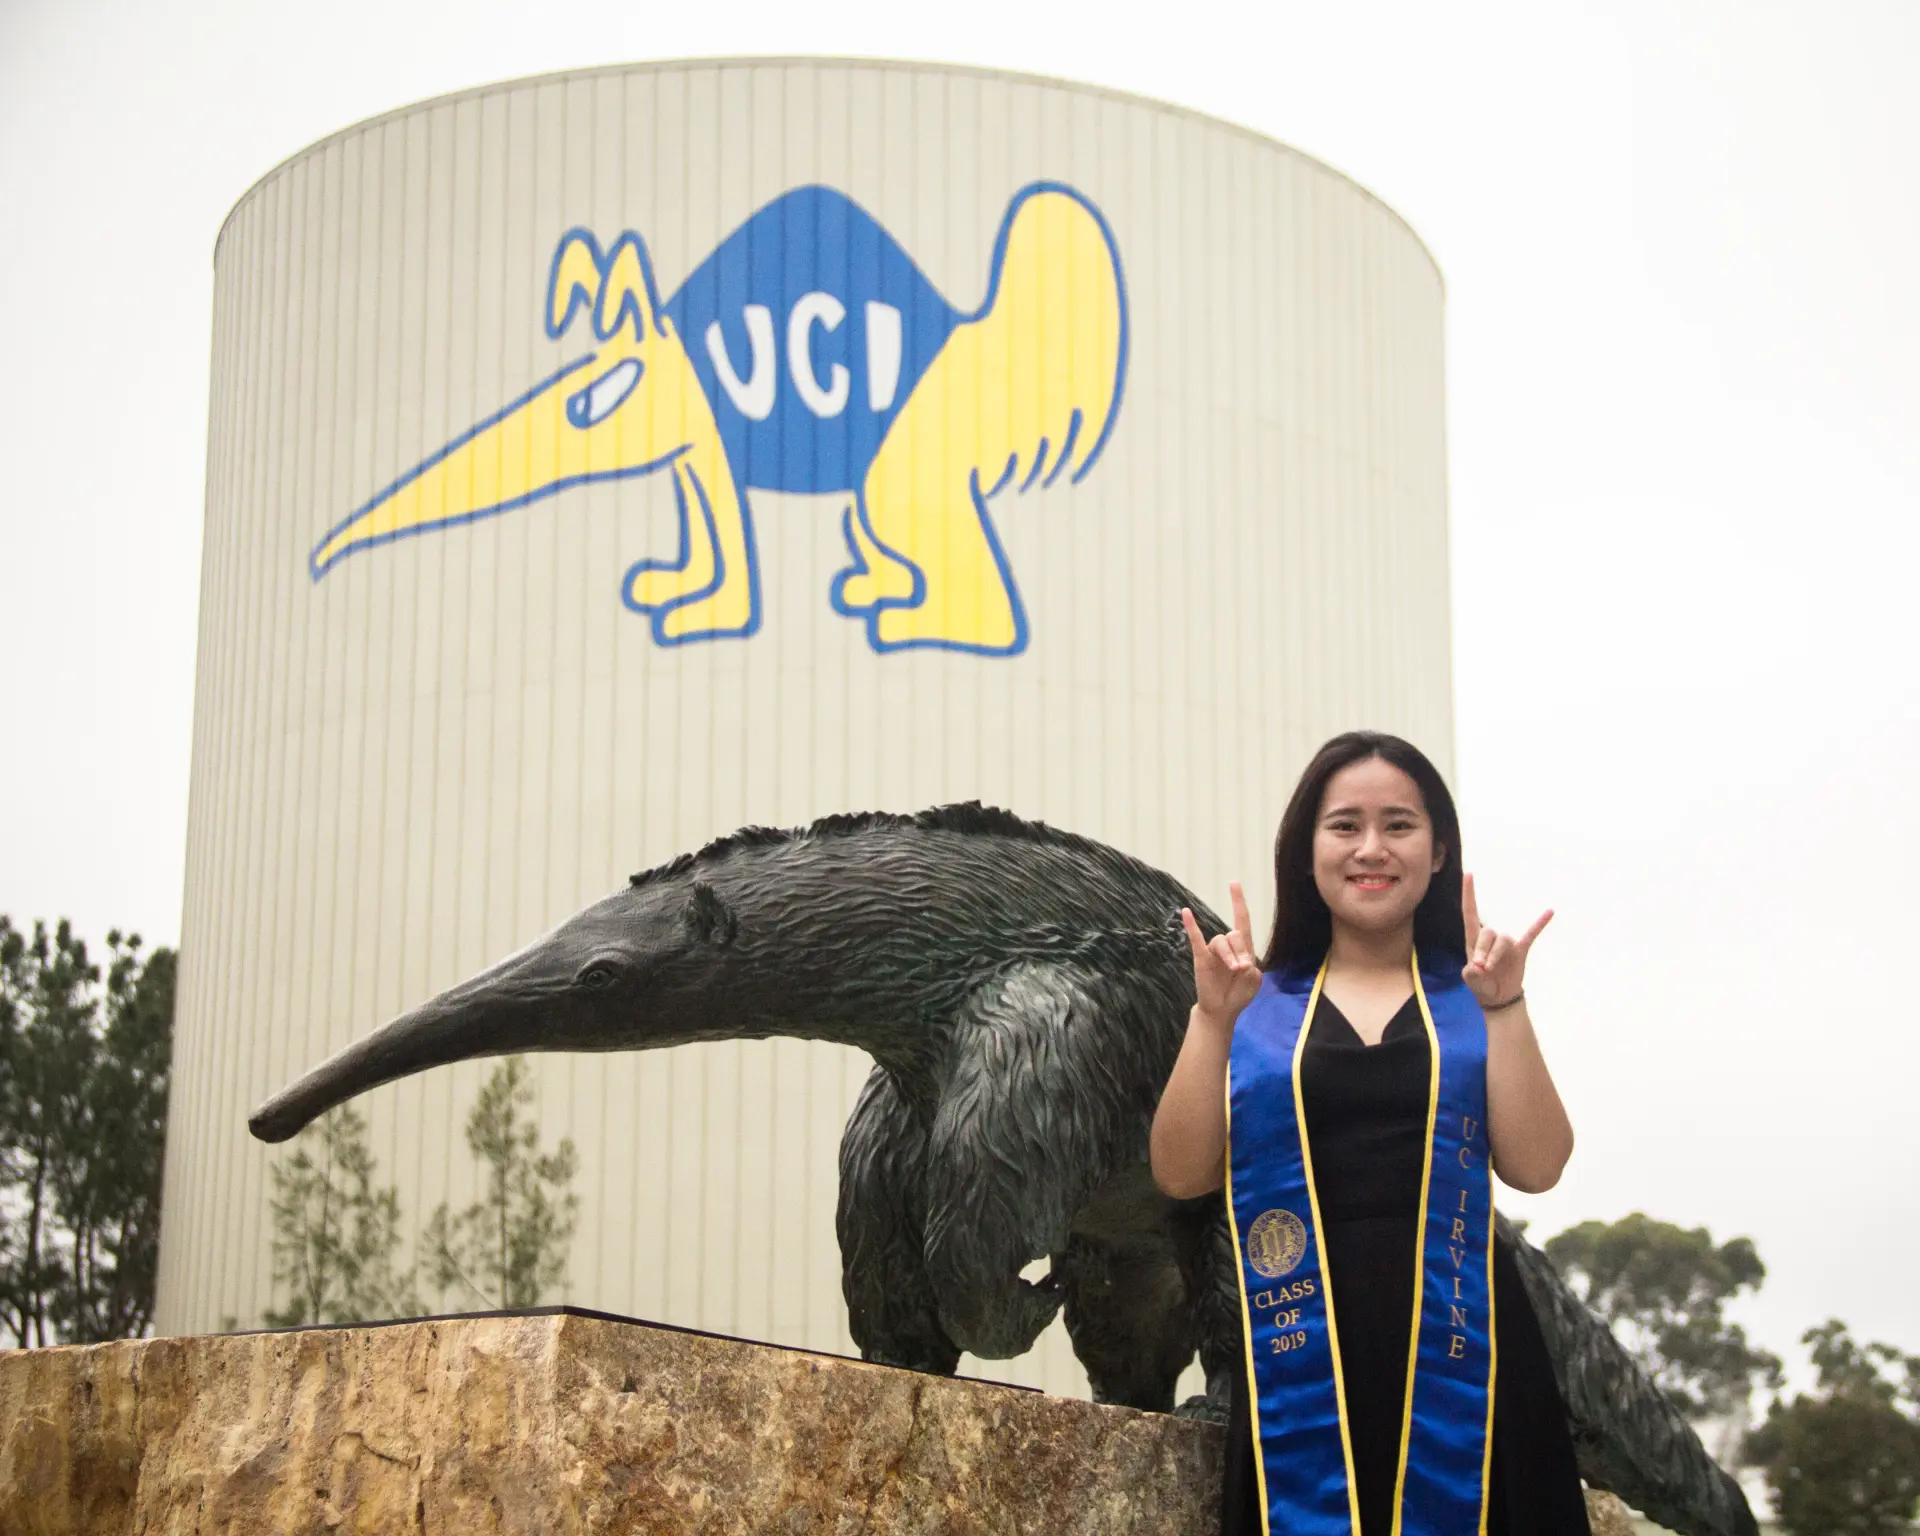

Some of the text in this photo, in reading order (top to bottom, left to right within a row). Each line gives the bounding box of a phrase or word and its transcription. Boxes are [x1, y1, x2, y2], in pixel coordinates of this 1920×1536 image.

[705, 290, 902, 421] UCI
[1448, 1116, 1478, 1359] UC IRVINE
[1255, 1279, 1315, 1309] CLASS
[1275, 1308, 1301, 1328] OF
[1271, 1331, 1306, 1354] 2019
